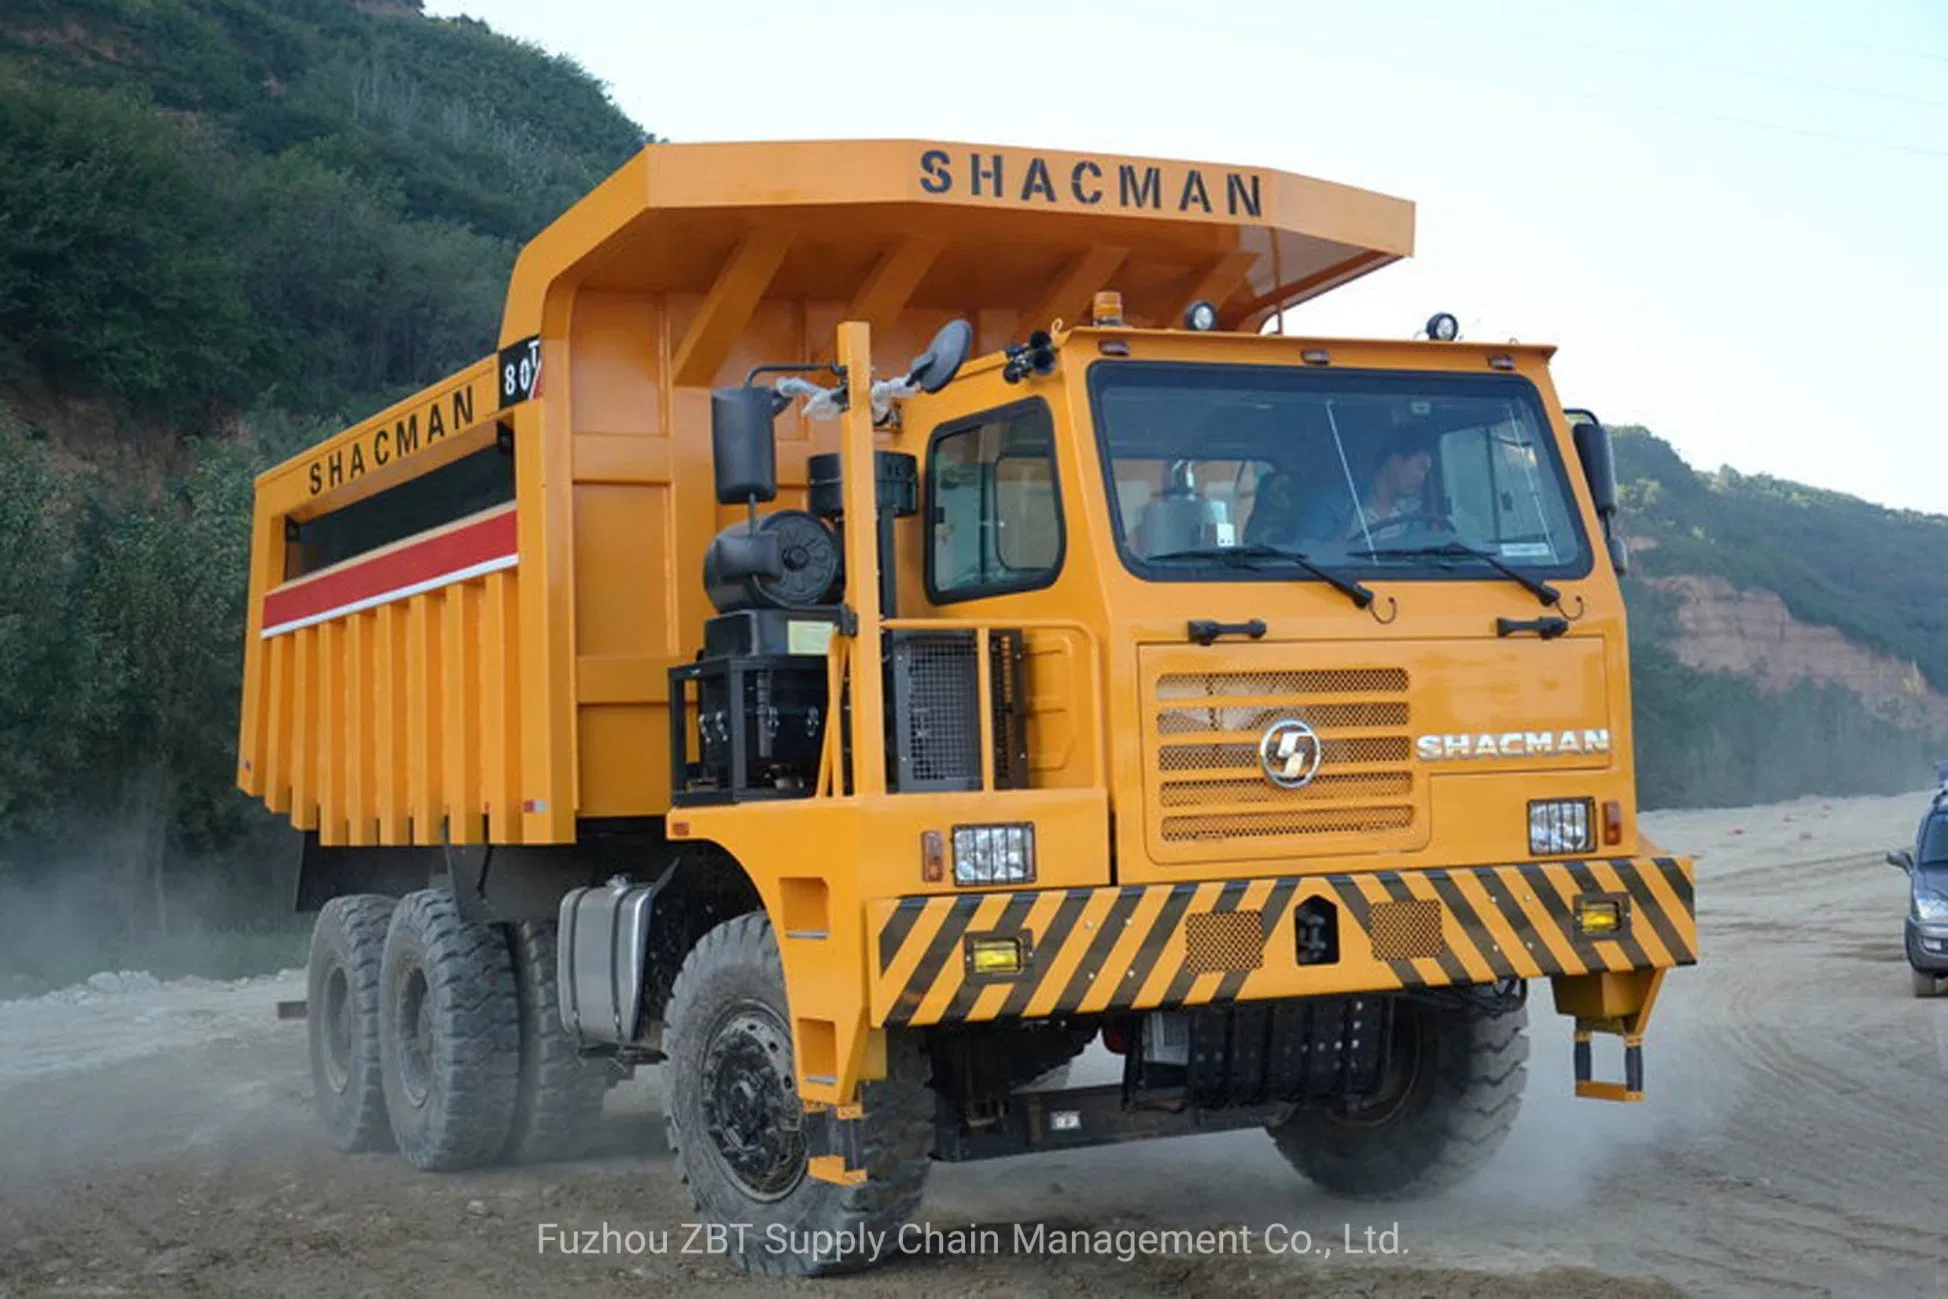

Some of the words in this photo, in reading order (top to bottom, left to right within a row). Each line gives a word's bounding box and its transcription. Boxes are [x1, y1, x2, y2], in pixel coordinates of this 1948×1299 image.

[919, 149, 1262, 218] SHACMAN
[309, 385, 474, 495] SHACMAN
[1416, 729, 1610, 760] SHACMAN
